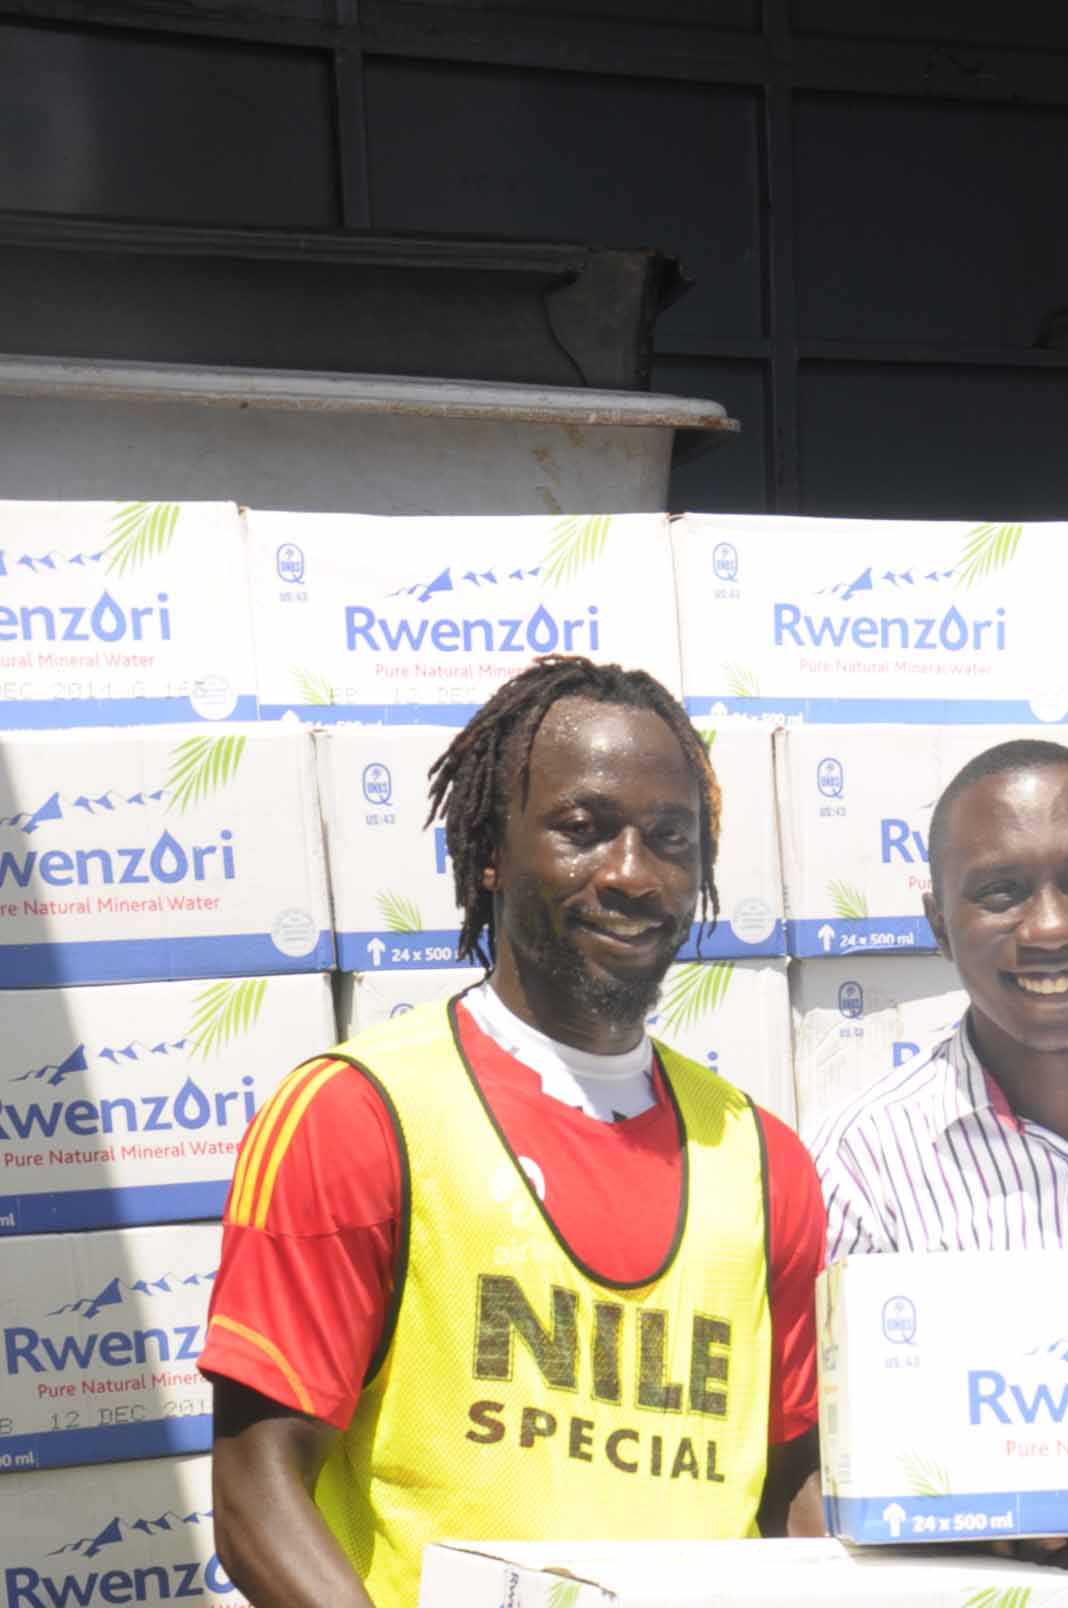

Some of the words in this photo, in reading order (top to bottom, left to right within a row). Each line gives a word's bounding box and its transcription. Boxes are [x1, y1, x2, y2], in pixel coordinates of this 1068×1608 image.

[345, 603, 600, 652] Rwenzori
[773, 604, 1006, 651] Rwenzori
[38, 653, 99, 668] Mineral
[105, 654, 155, 667] Water
[376, 664, 409, 678] Pure
[415, 664, 472, 678] Natural
[800, 658, 829, 673] Pure
[835, 660, 889, 674] Natural
[895, 661, 945, 676] Mineral
[951, 661, 992, 675] Water
[24, 898, 91, 917] Natural
[97, 896, 163, 914] Mineral
[168, 895, 221, 912] Water
[391, 948, 410, 962] 24
[425, 947, 452, 961] 500
[0, 1075, 255, 1140] wenzori
[4, 1152, 44, 1168] Pure
[49, 1146, 115, 1164] Natural
[121, 1141, 185, 1161] Mineral
[189, 1140, 240, 1156] Water
[4, 1325, 208, 1375] Rwenz
[473, 1273, 732, 1421] NILE
[37, 1382, 76, 1399] Pure
[81, 1376, 145, 1395] Natural
[51, 1411, 81, 1431] 12
[97, 1404, 146, 1426] DEC
[466, 1400, 725, 1483] SPECIAL
[1006, 1438, 1049, 1457] Pure
[912, 1514, 935, 1532] 24
[953, 1513, 987, 1531] 500
[990, 1510, 1014, 1529] ml
